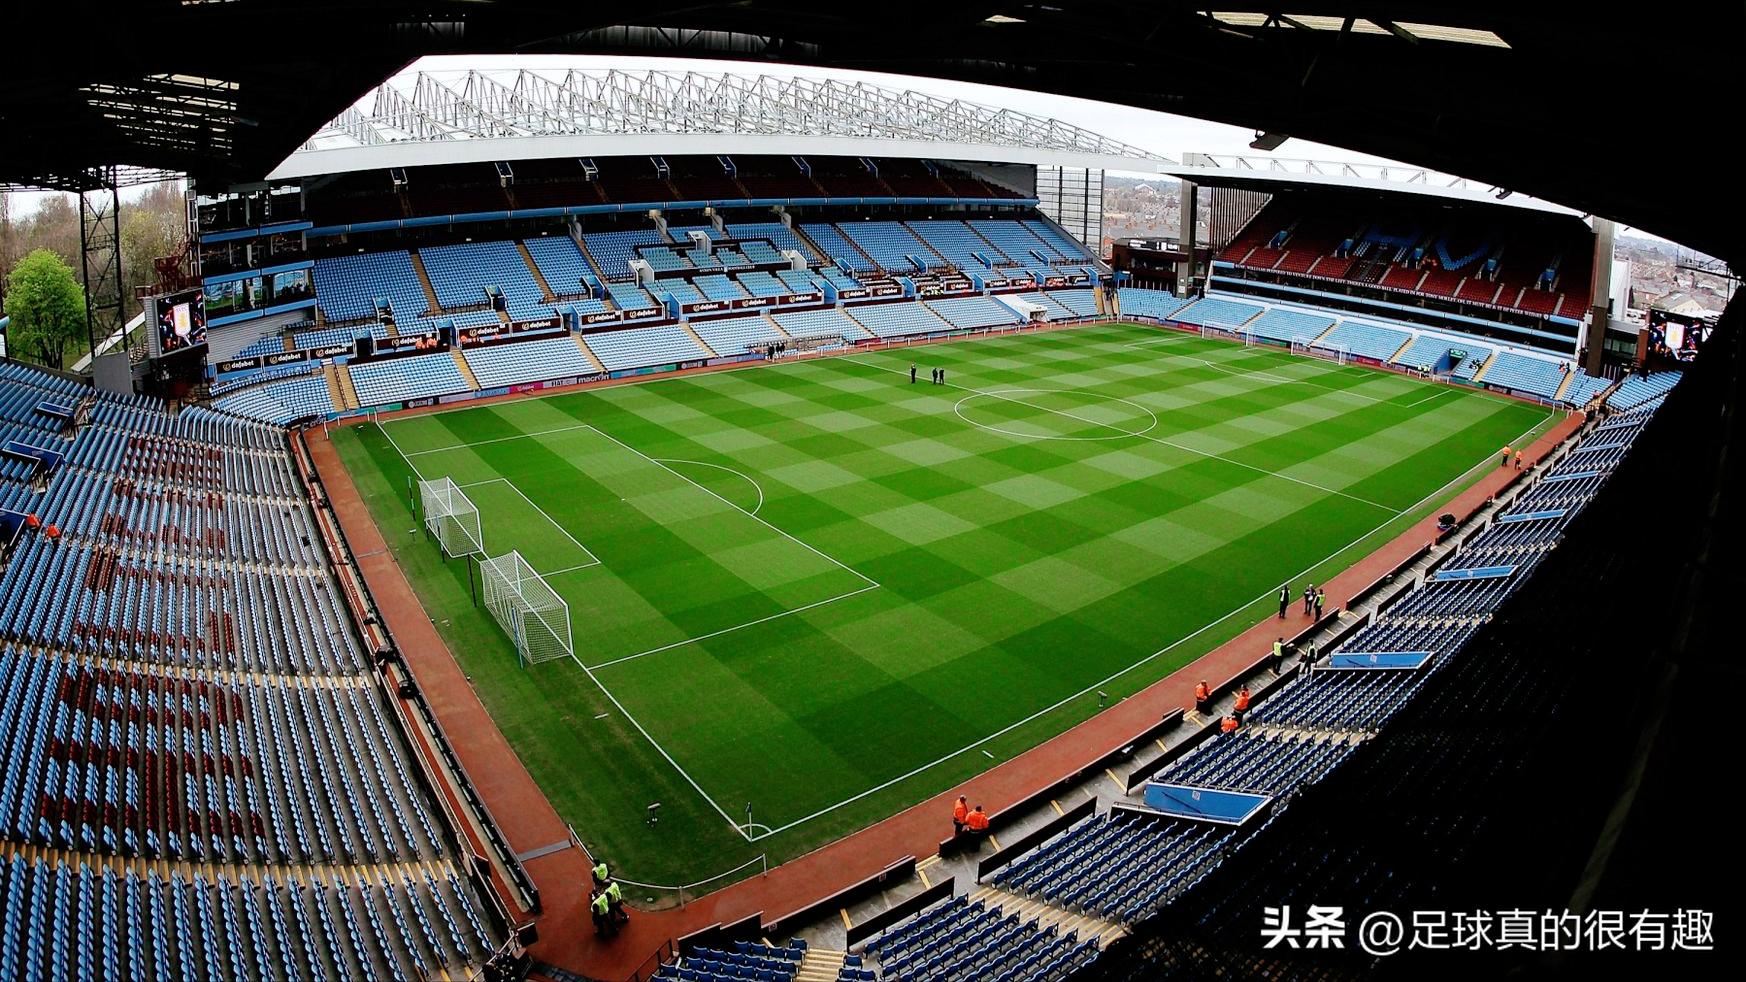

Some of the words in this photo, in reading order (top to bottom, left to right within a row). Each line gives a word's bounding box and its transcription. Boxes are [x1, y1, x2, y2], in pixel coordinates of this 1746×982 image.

[530, 320, 551, 328] dafabet
[478, 326, 499, 335] dafabet
[324, 346, 348, 355] dafabet
[278, 354, 301, 362] dafabet
[232, 360, 254, 369] dafabet
